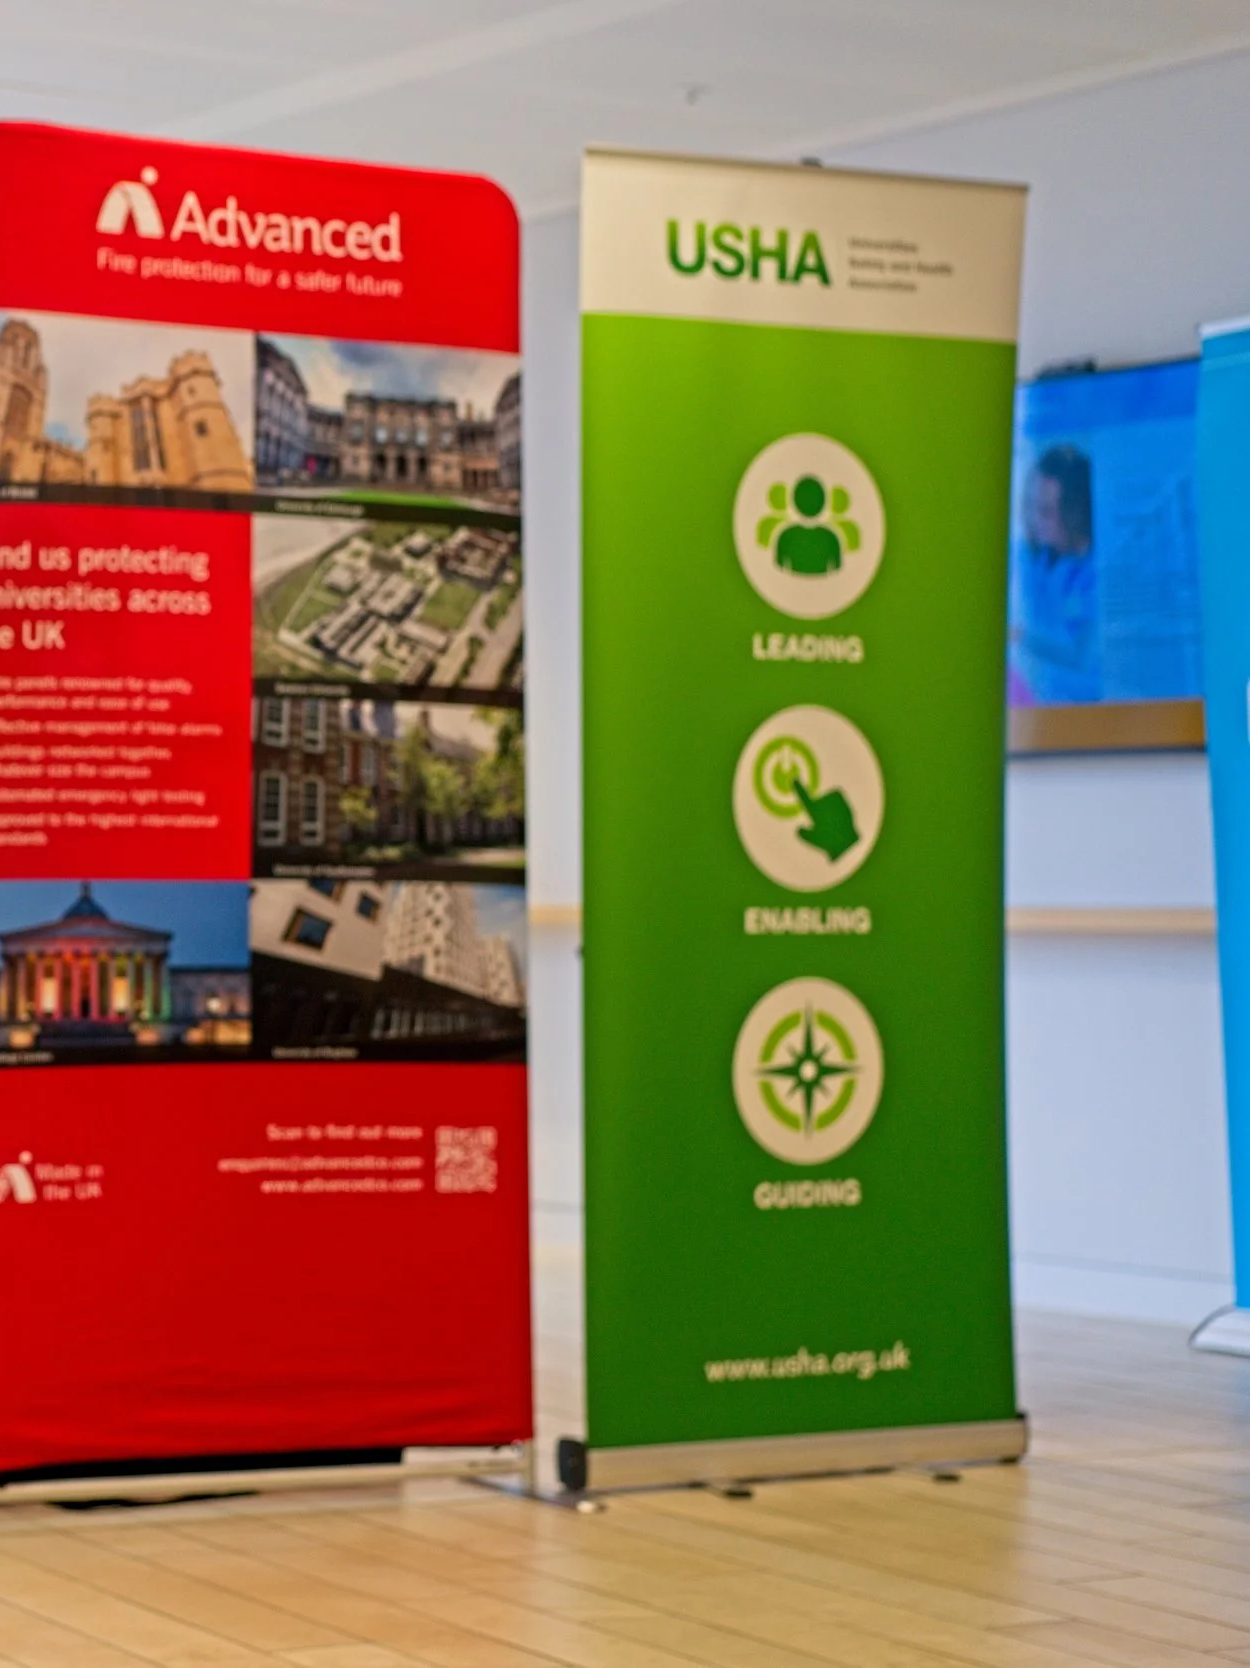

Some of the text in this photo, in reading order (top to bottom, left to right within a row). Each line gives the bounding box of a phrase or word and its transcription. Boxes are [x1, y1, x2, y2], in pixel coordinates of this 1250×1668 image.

[170, 190, 404, 263] Advanced
[666, 218, 832, 287] USHA
[97, 247, 404, 298] Fire protection for a safer future
[38, 546, 71, 571] us
[78, 544, 210, 582] protecting
[127, 588, 212, 616] across
[21, 620, 66, 650] UK
[752, 632, 865, 662] LEADING
[743, 906, 871, 935] ENABLING
[754, 1178, 861, 1211] GUIDING
[705, 1340, 910, 1382] www.usha.org.uk
